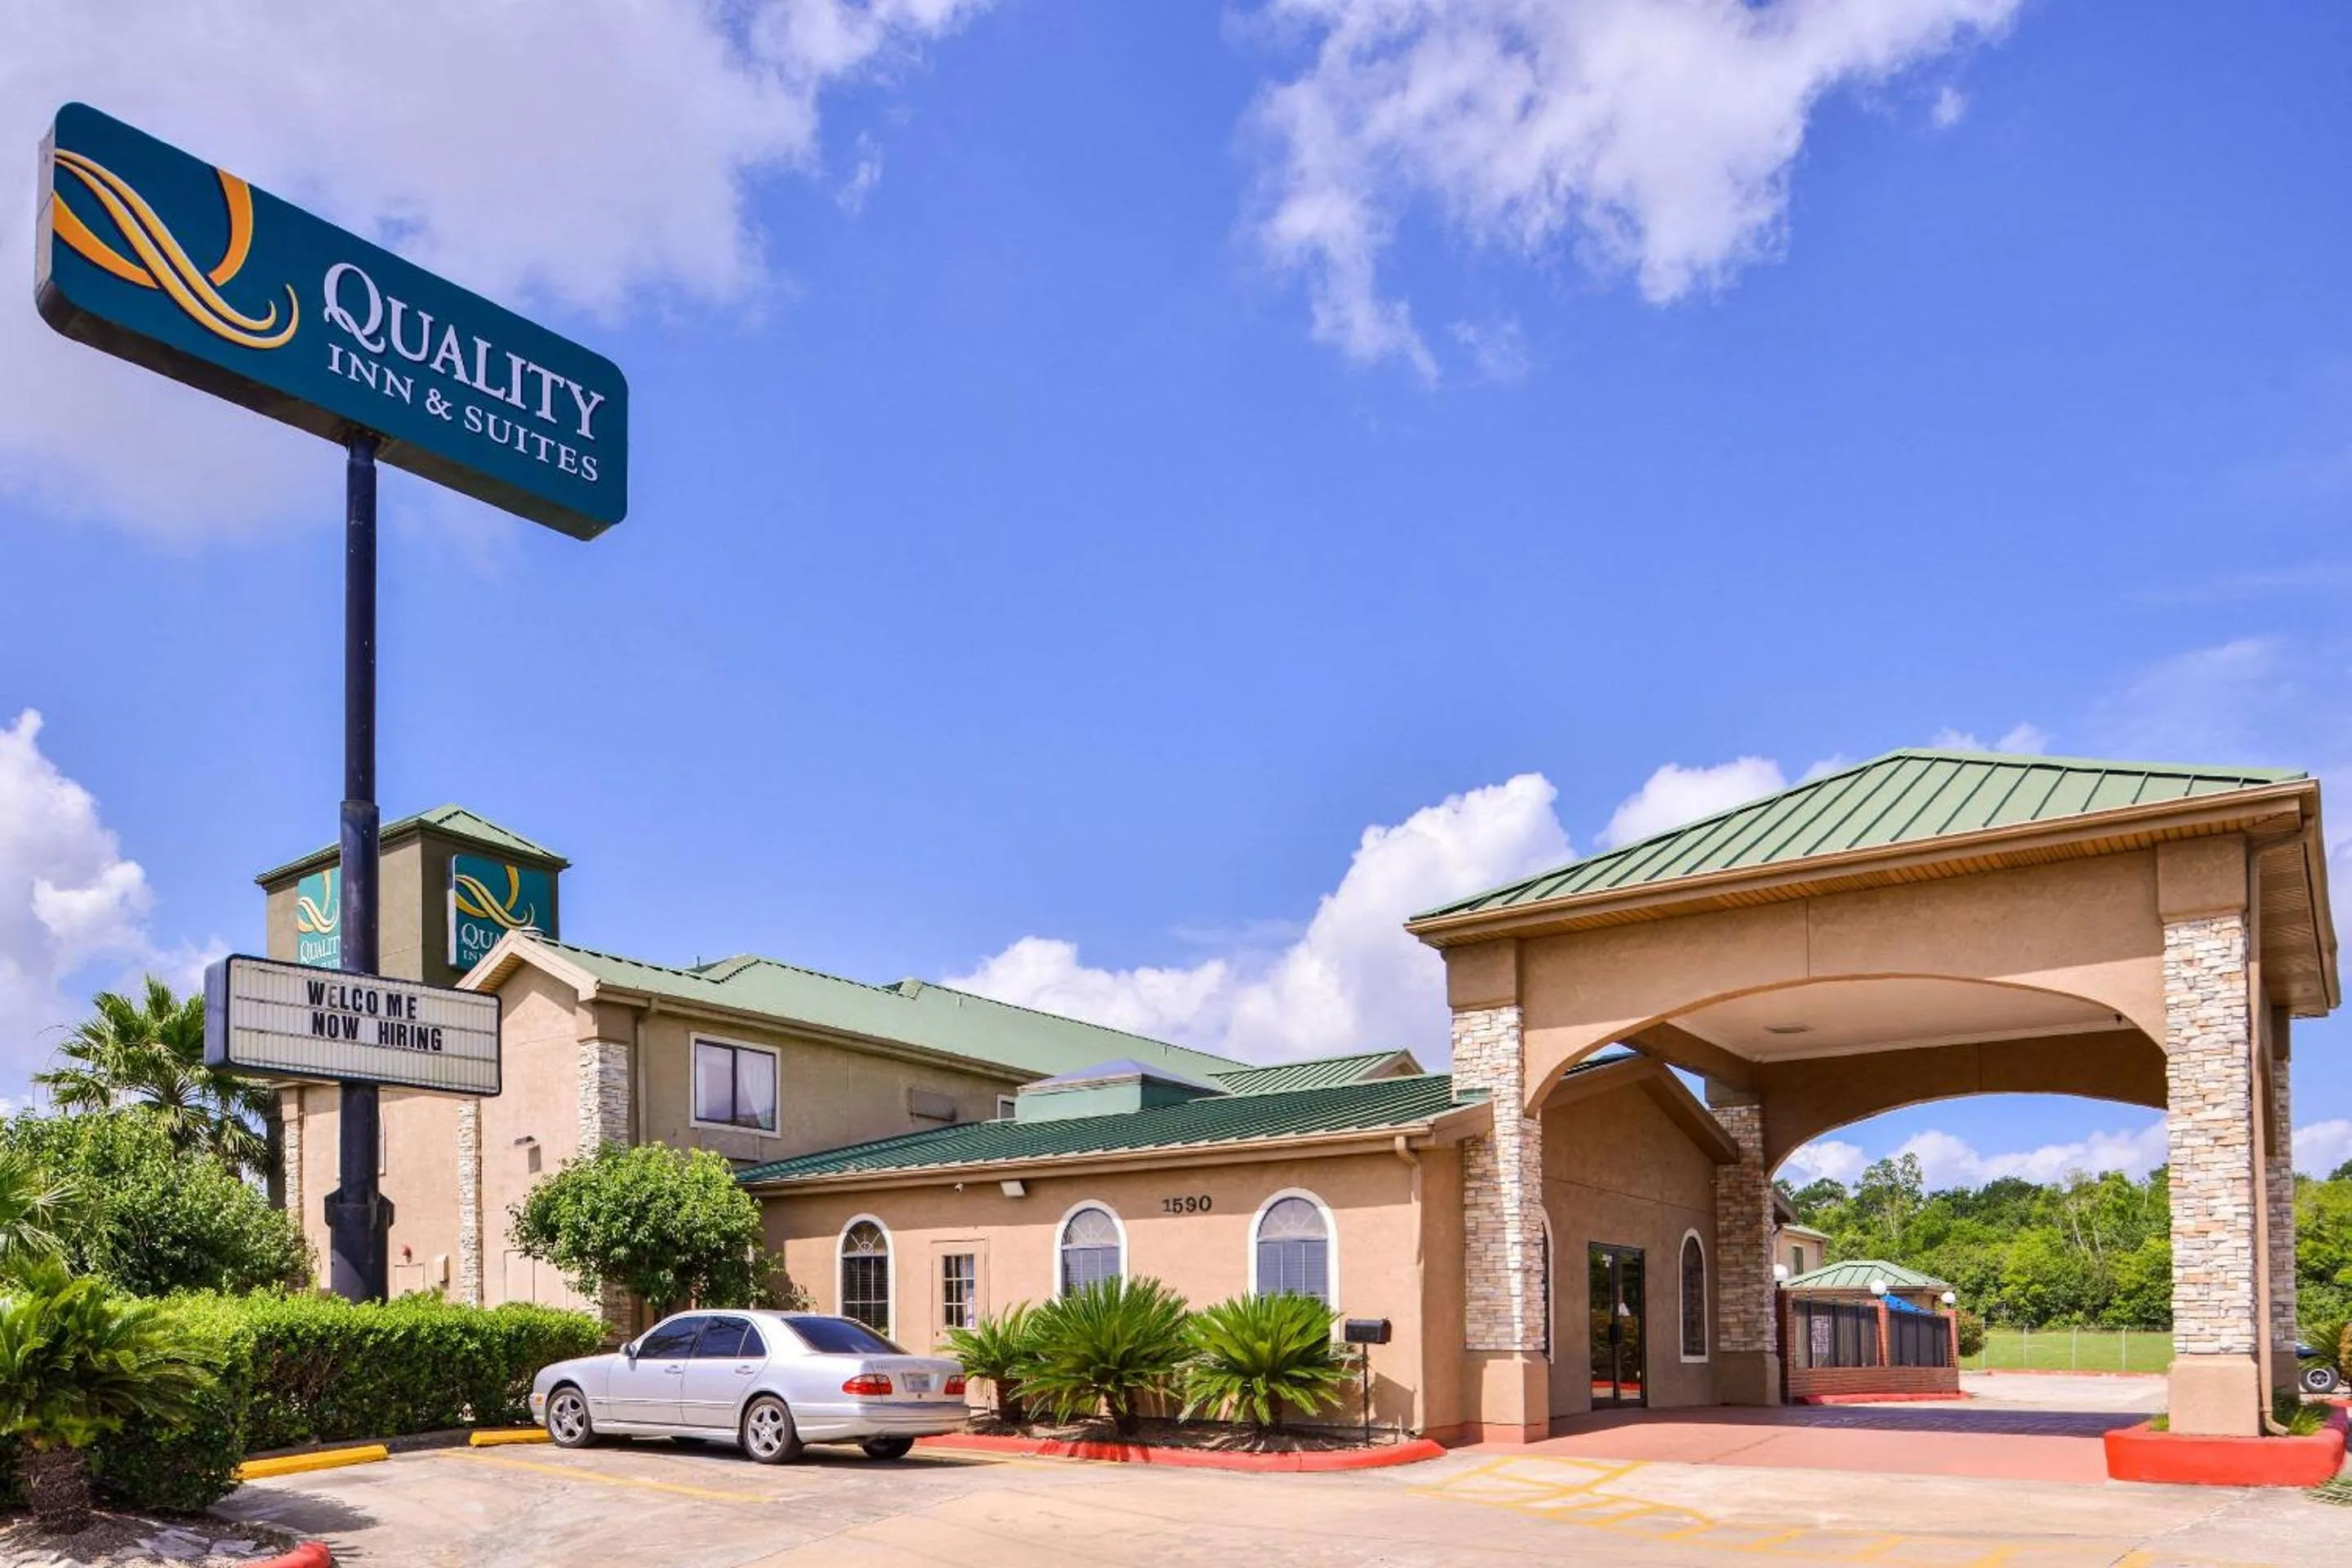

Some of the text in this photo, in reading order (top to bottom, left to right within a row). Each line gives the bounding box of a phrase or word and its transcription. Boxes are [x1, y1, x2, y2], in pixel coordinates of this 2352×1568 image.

[323, 262, 605, 440] QUALITY
[327, 342, 599, 482] INN & SUITES
[312, 1011, 442, 1051] NOW HIRING
[1161, 1195, 1212, 1214] 1590
